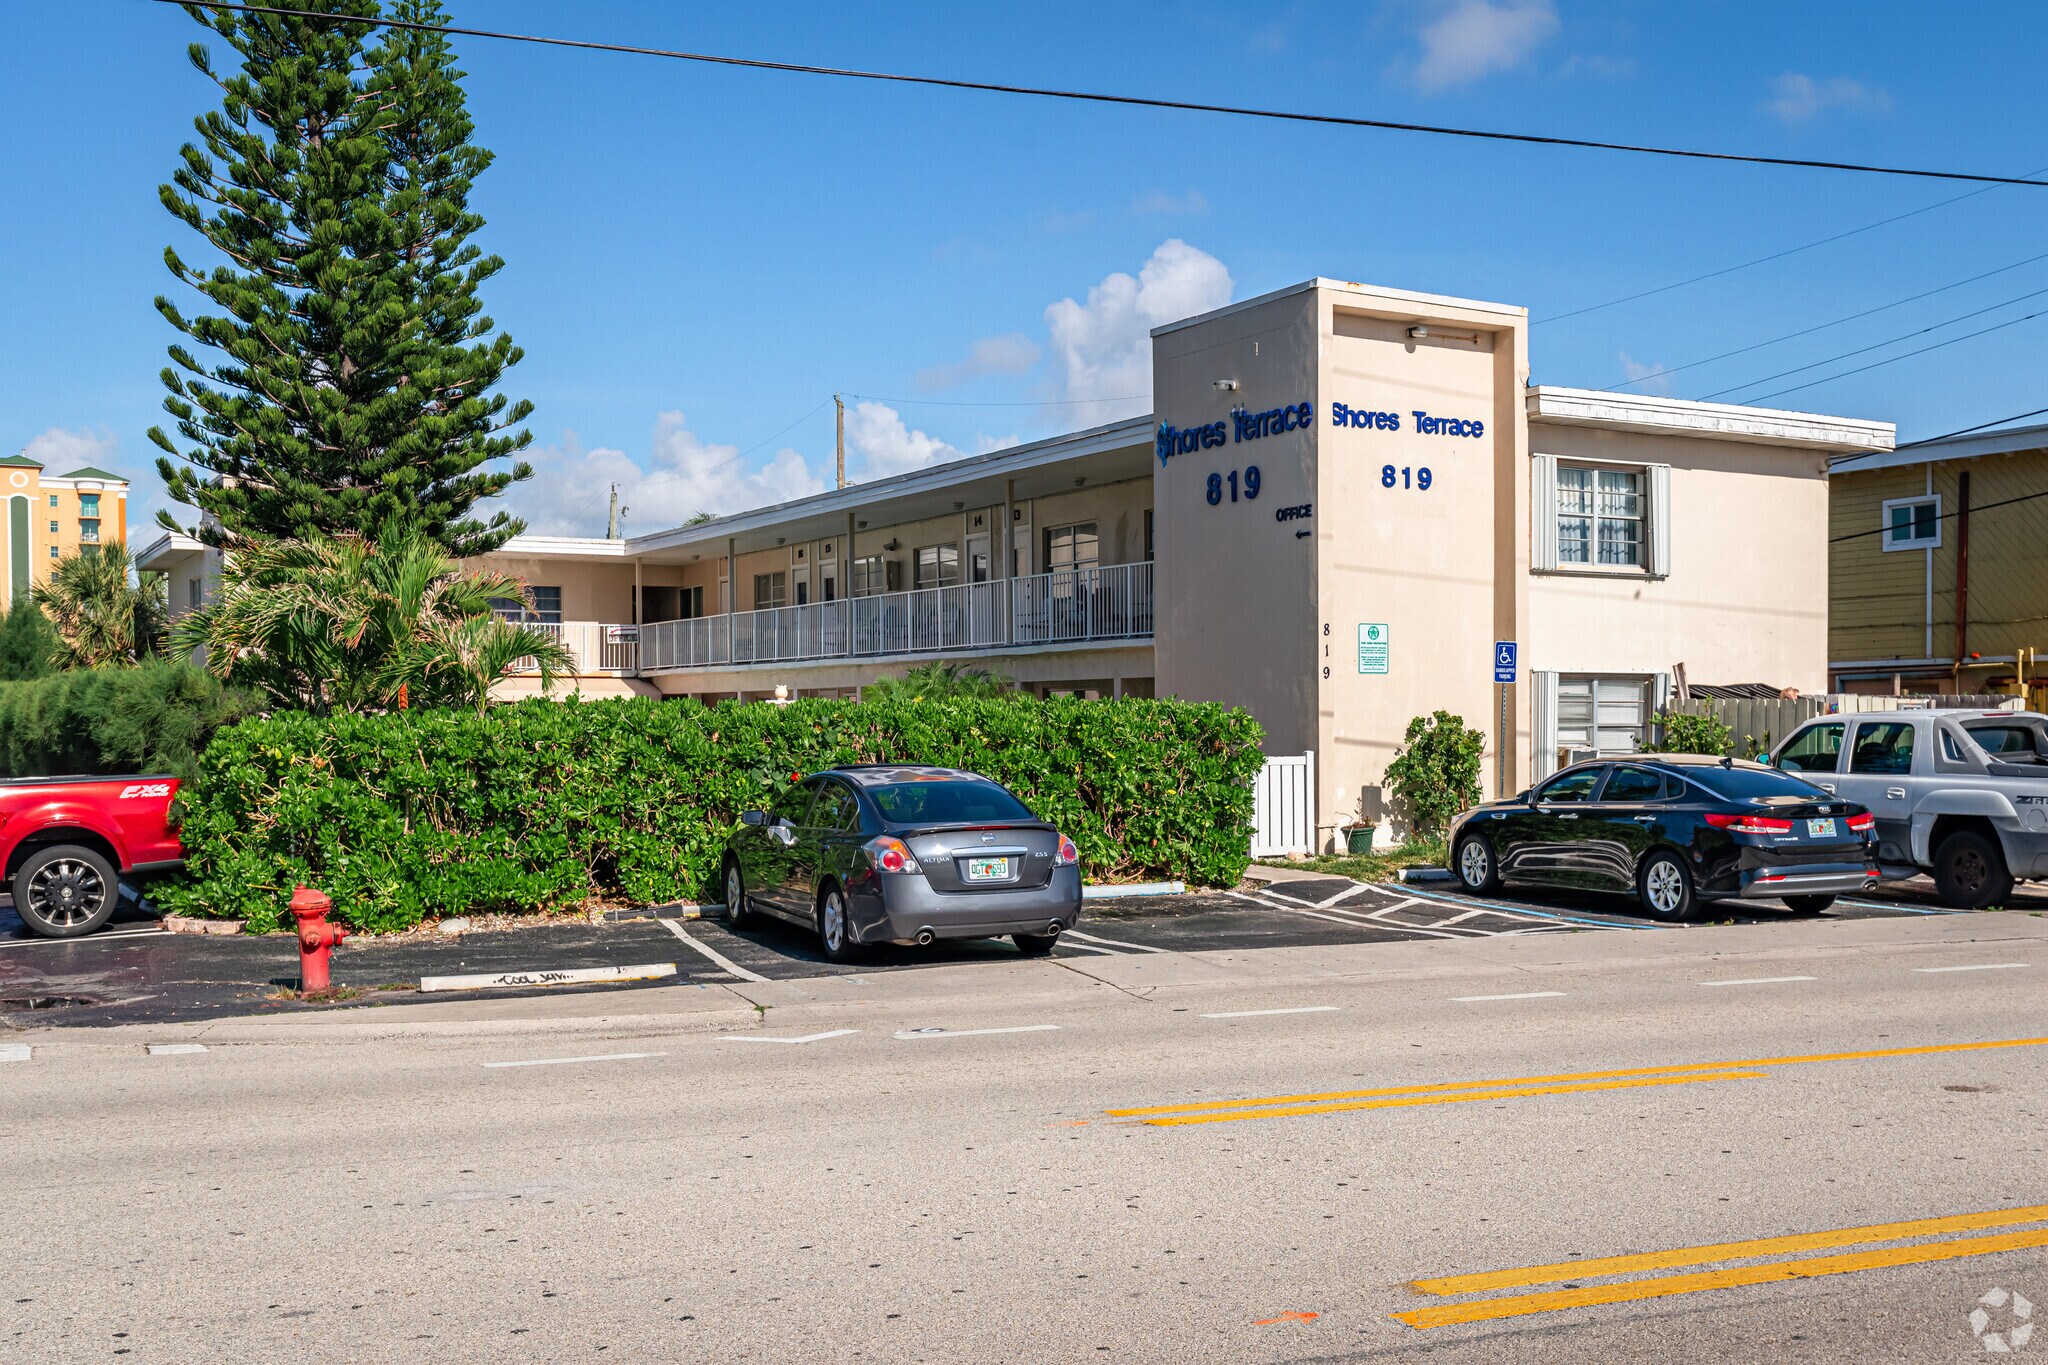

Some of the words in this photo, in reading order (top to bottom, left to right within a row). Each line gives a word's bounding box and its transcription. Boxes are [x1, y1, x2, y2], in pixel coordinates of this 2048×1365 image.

[1157, 421, 1227, 459] Shores
[1230, 401, 1313, 443] Terrace
[1332, 402, 1400, 431] Shores
[1412, 410, 1484, 438] Terrace
[1206, 466, 1261, 505] 819
[1382, 465, 1432, 491] 819
[974, 515, 982, 527] 14
[1276, 504, 1312, 522] OFFICE
[825, 544, 832, 554] 15
[121, 784, 170, 795] FX4
